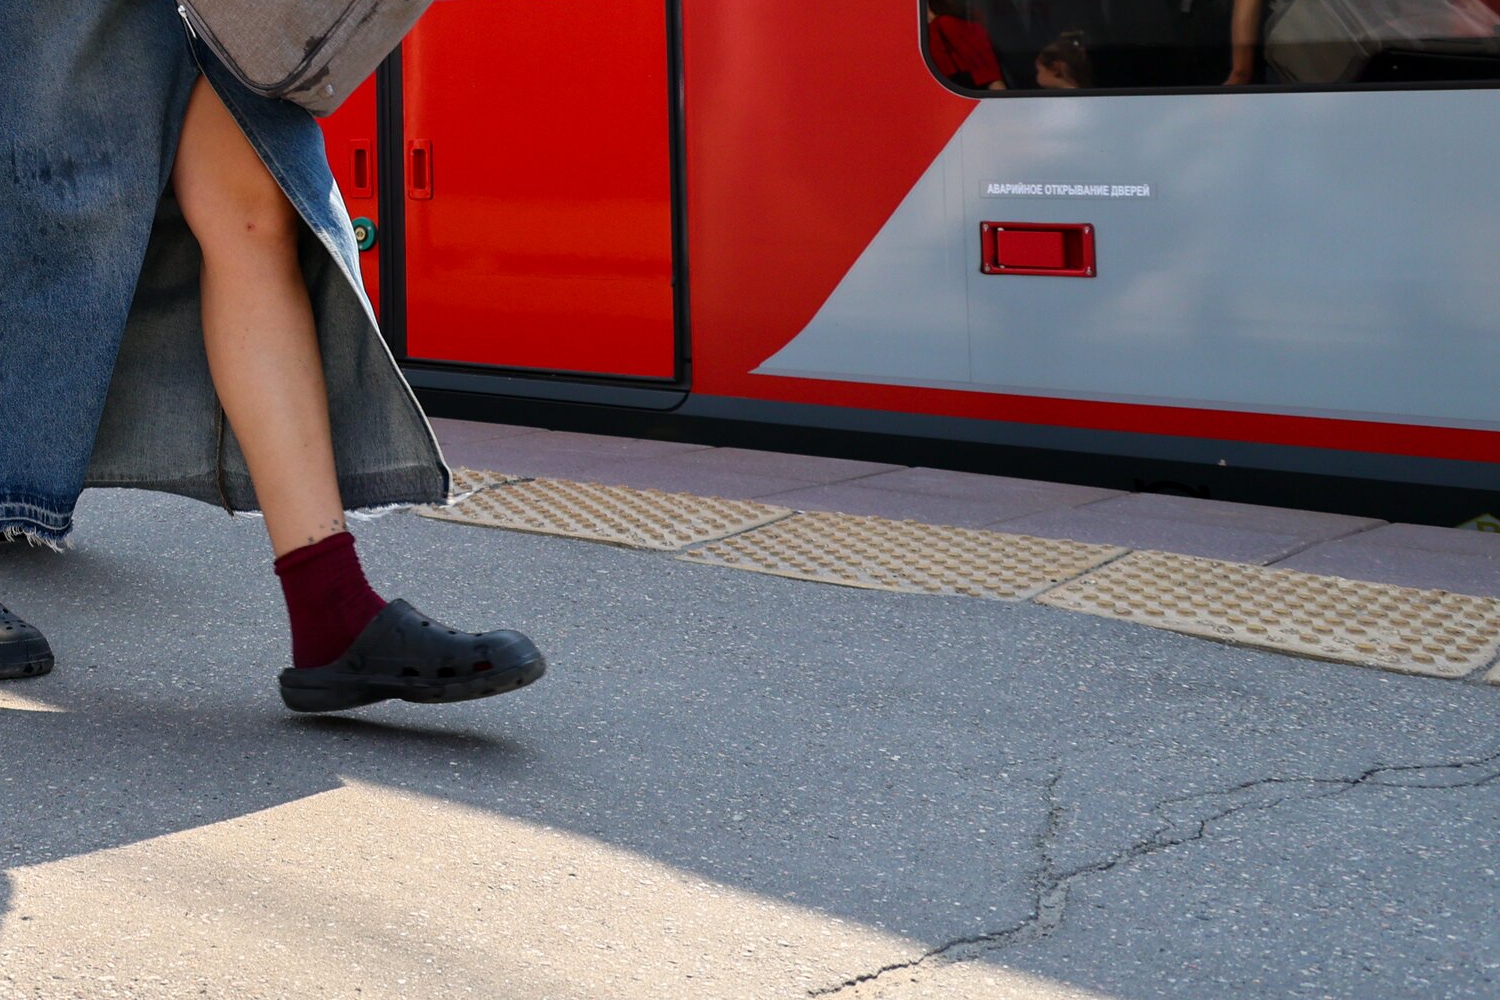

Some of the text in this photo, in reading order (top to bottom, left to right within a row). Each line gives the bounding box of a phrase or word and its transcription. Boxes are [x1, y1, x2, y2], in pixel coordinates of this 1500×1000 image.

[987, 182, 1150, 197] АВАРИЙНОЕ ОТКРЫВАНИЕ ДВЕРЕЙ
